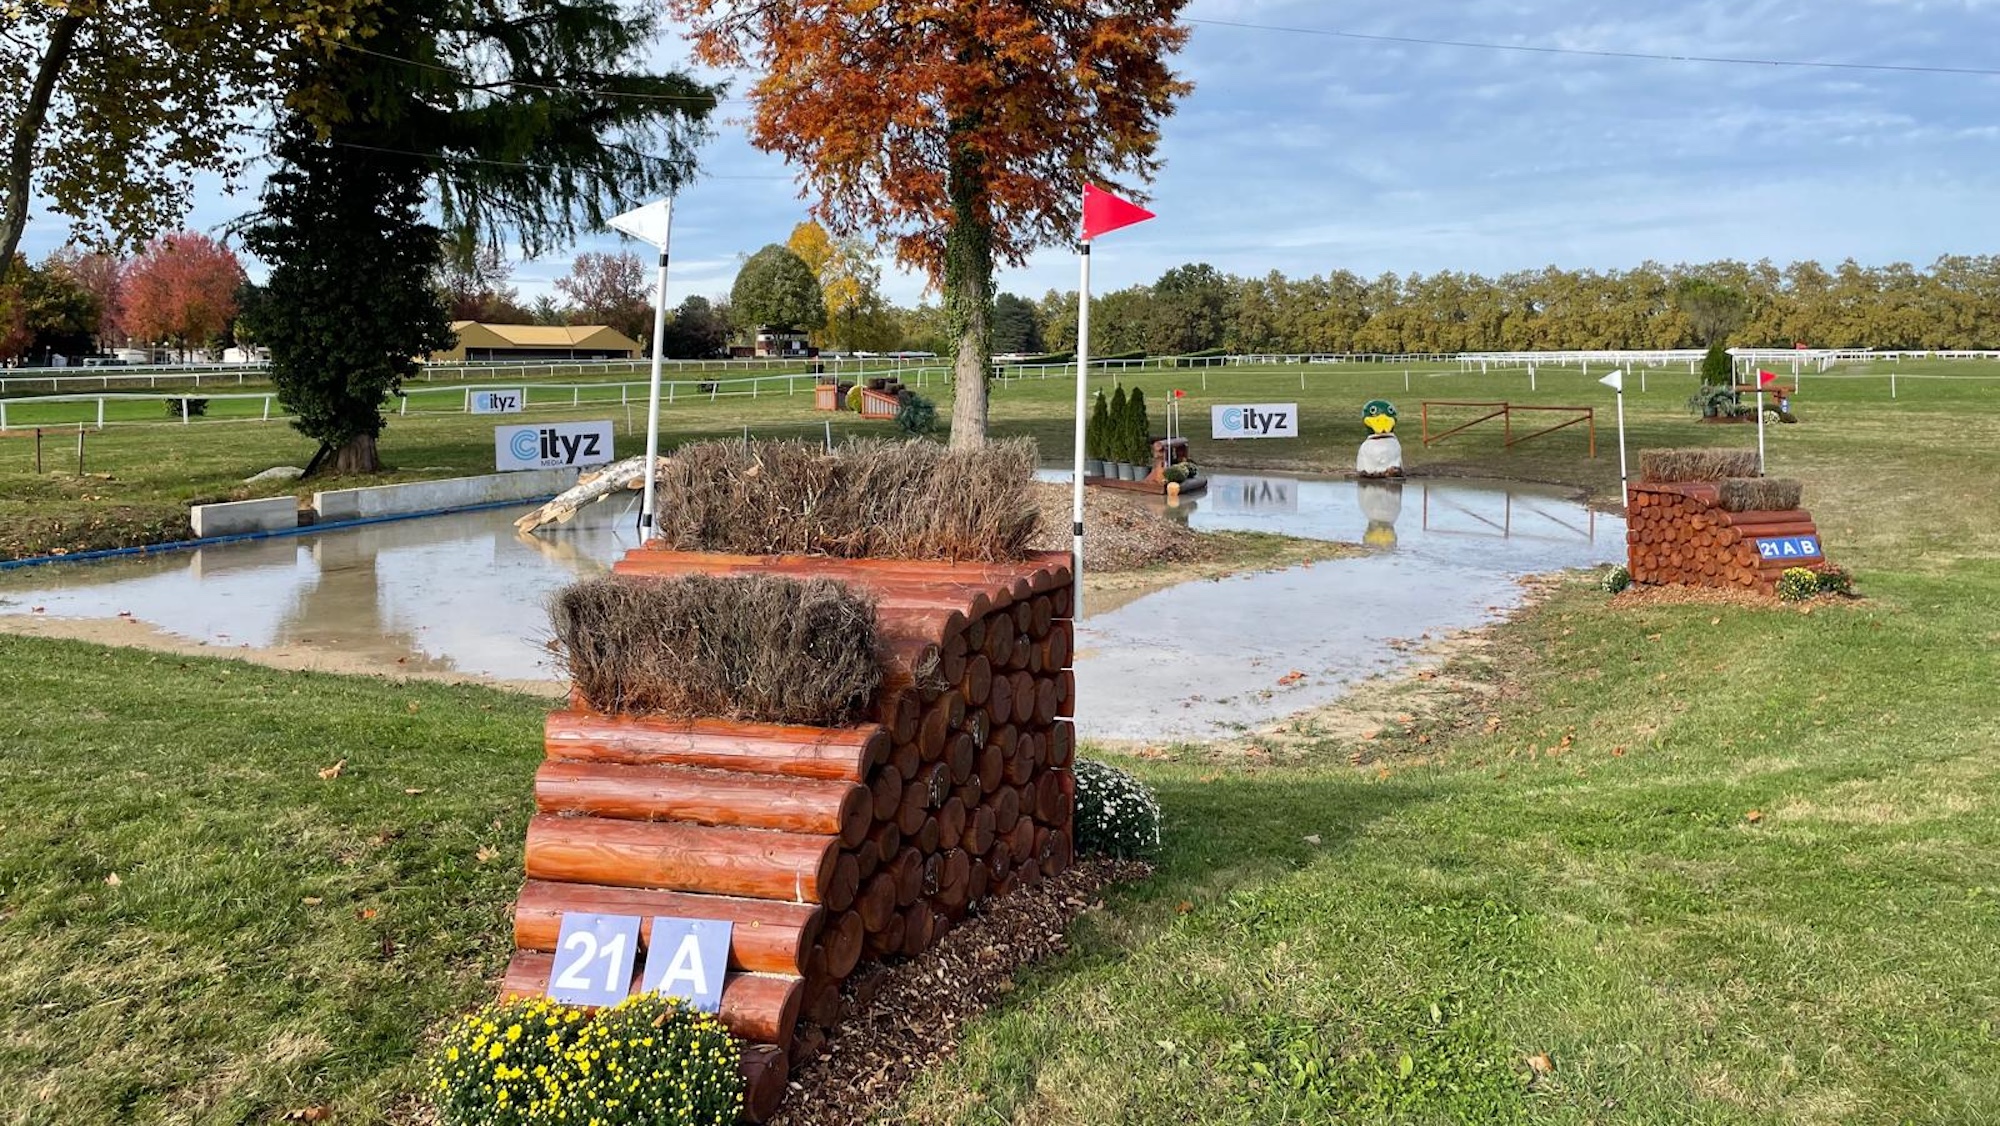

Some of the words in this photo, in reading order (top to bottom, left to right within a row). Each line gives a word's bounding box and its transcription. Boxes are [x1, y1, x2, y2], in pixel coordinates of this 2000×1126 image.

[477, 393, 515, 411] Cityz
[1222, 408, 1287, 434] Cityz
[510, 428, 600, 464] Cityz
[1760, 541, 1780, 556] 21
[1783, 541, 1797, 555] A
[1800, 540, 1815, 554] B
[555, 931, 626, 992] 21
[659, 934, 708, 994] A
